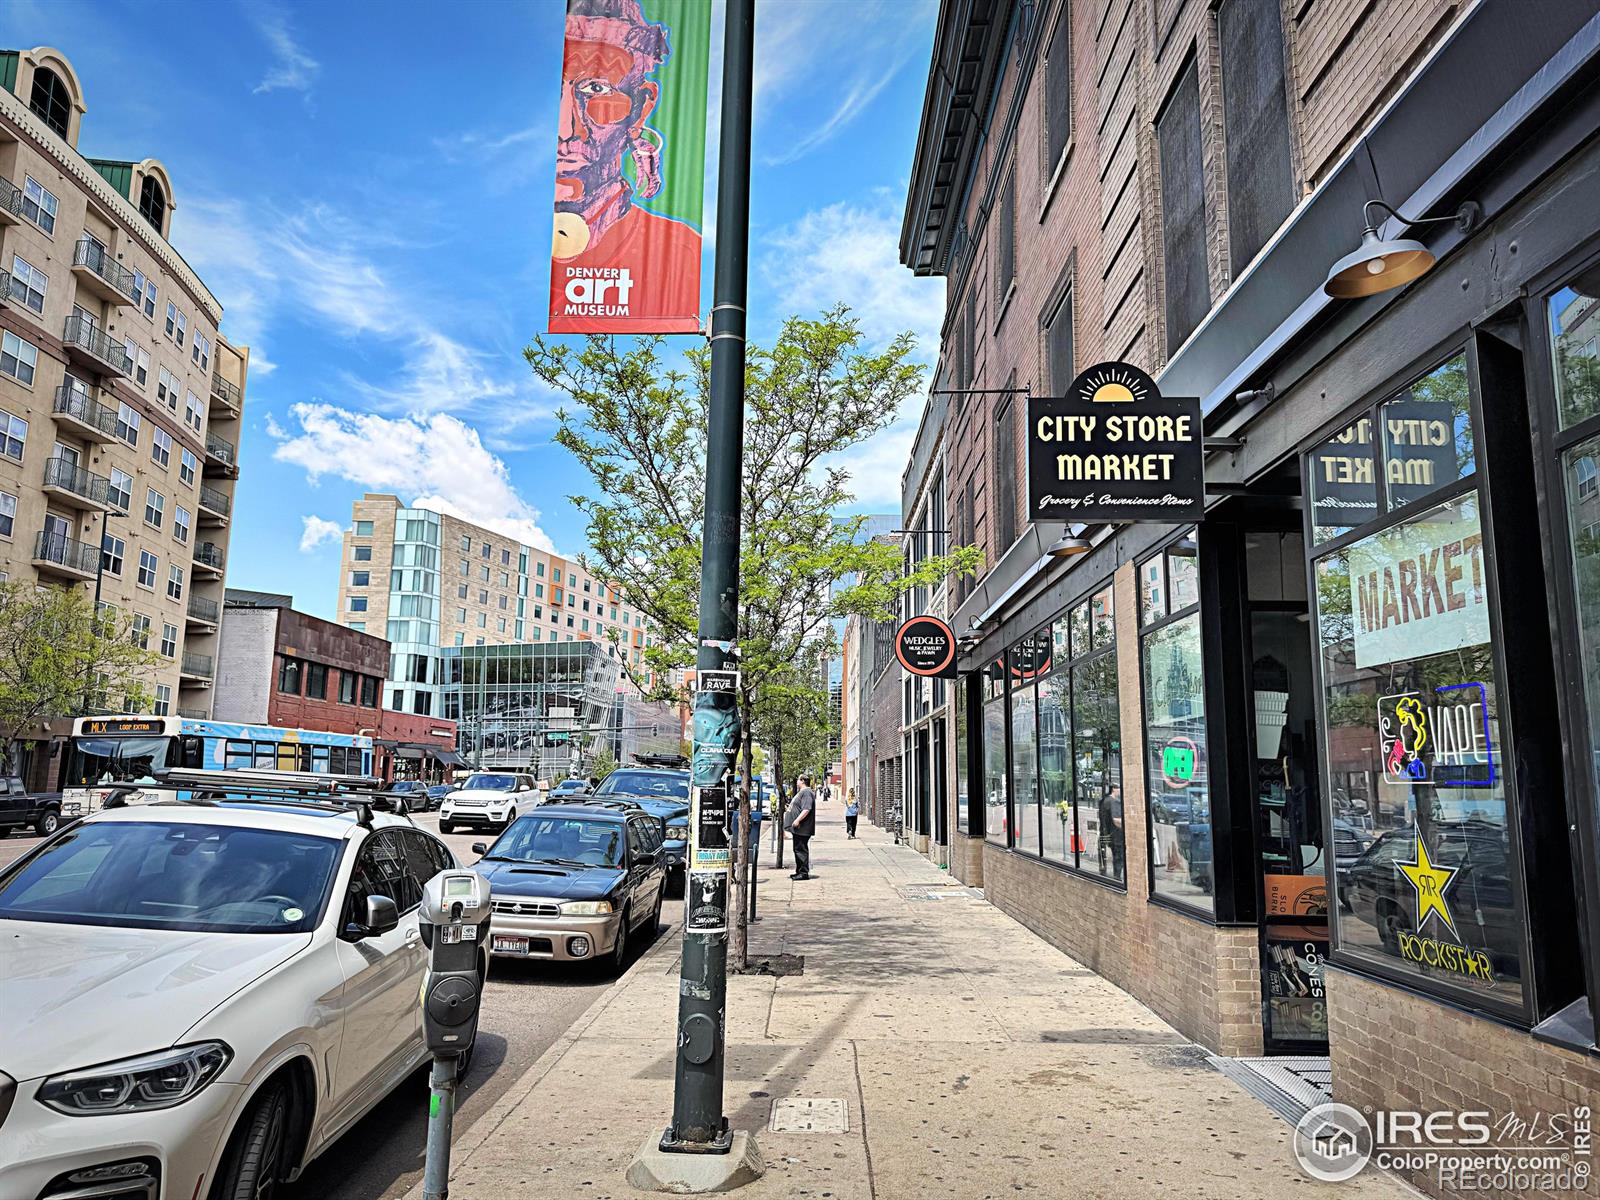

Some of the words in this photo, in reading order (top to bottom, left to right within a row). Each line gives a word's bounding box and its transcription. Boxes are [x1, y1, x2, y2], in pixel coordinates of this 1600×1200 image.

[566, 267, 619, 278] DENVER
[565, 268, 634, 305] art
[564, 304, 630, 316] MUSEUM
[1037, 415, 1097, 442] CITY
[1106, 415, 1193, 442] STORE
[1056, 454, 1175, 481] MARKET
[1038, 494, 1082, 510] Grocery
[1082, 492, 1095, 507] &
[1357, 533, 1483, 635] MARKET
[903, 636, 946, 645] WEDGLES
[706, 681, 731, 690] RAVE
[91, 722, 107, 733] MLX
[1427, 703, 1489, 766] VAPE
[1304, 942, 1323, 998] CONES
